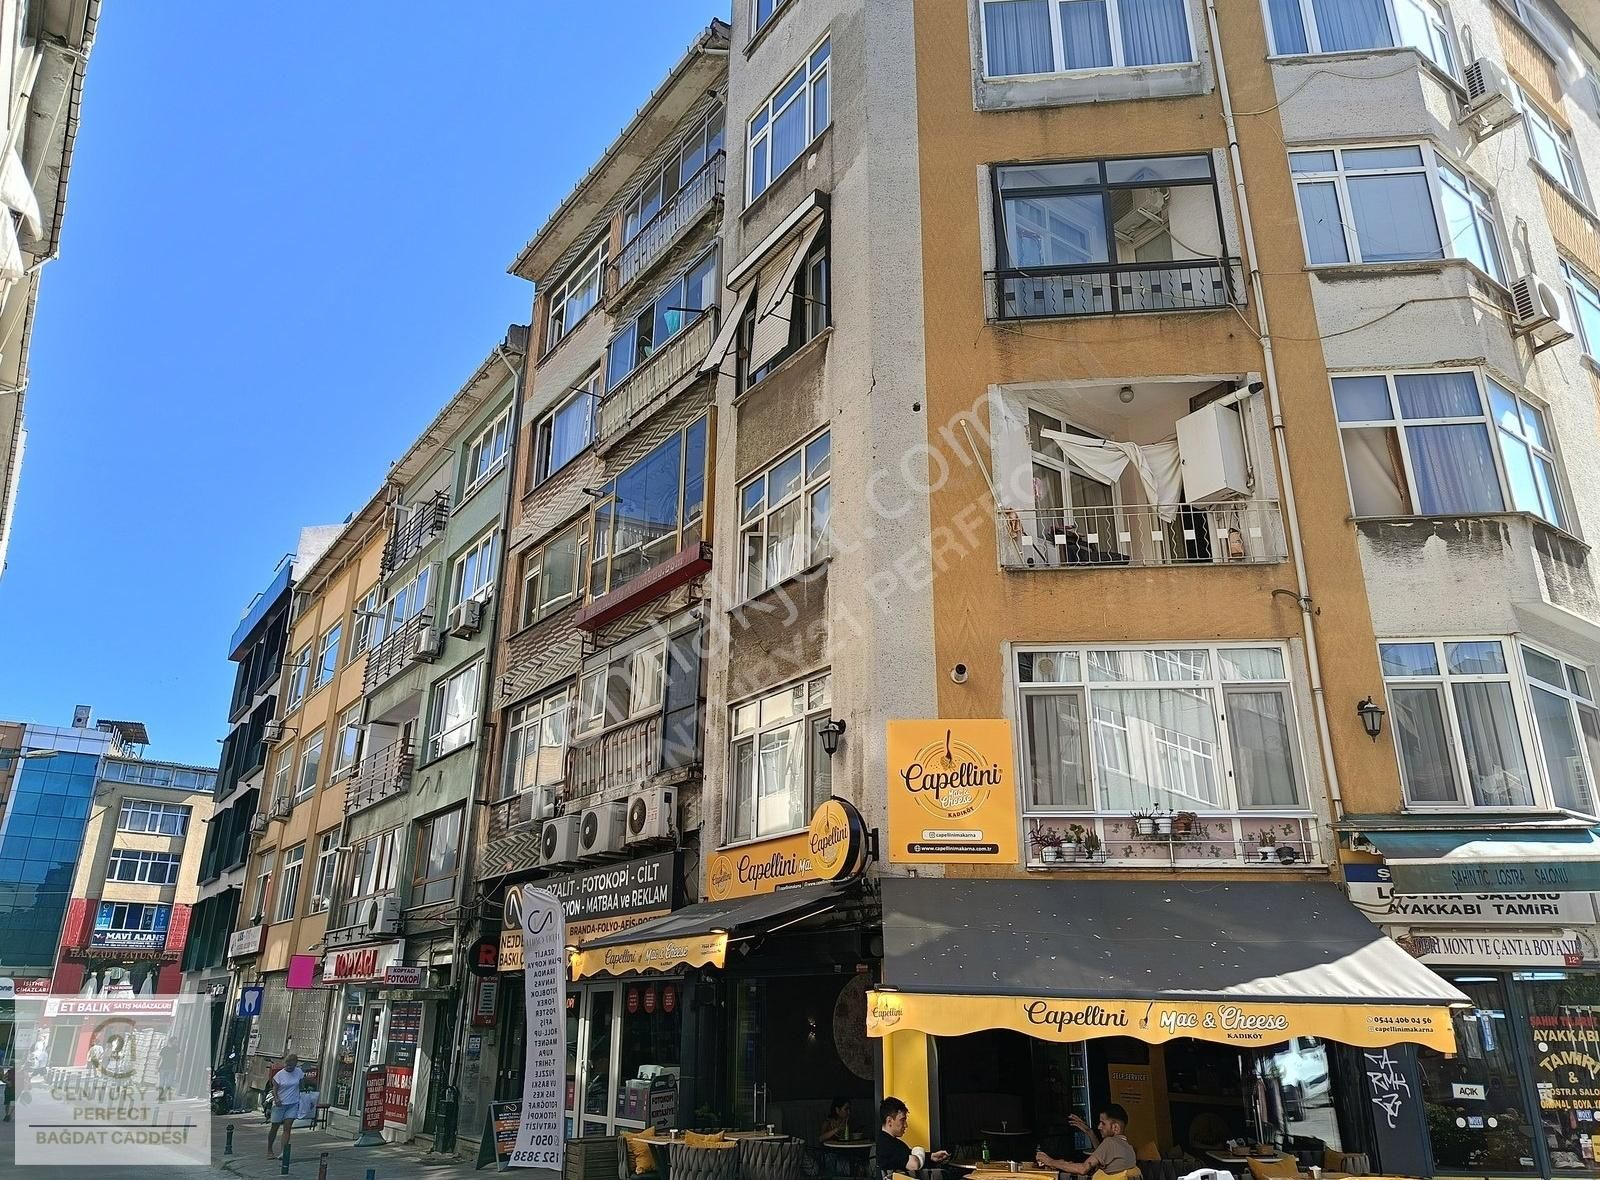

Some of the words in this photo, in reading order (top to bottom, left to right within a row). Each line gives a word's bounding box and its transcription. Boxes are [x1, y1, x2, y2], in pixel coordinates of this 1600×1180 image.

[900, 763, 1002, 799] Capellini
[940, 793, 972, 809] Cheese
[810, 824, 849, 858] Capellini
[581, 864, 629, 894] FOTOKOPİ
[637, 860, 660, 884] CİLT
[736, 853, 797, 891] Capellini
[1495, 868, 1526, 886] LOSTRA
[1534, 867, 1568, 884] SALONU
[586, 893, 619, 914] MATBAA
[620, 894, 630, 909] ve
[631, 884, 668, 907] REKLAM
[1387, 903, 1482, 915] AYAKKABI
[106, 931, 133, 941] MAVİ
[134, 932, 166, 942] AJANS
[1442, 938, 1475, 955] MONT
[1476, 938, 1492, 955] VE
[1493, 938, 1533, 960] ÇANTA
[334, 949, 378, 977] KOPYACI
[499, 952, 519, 966] BASKI
[605, 946, 636, 970] Capellini
[386, 974, 420, 984] FOTOKOPİ
[60, 1003, 76, 1012] ET
[78, 1003, 111, 1013] BALIK
[871, 1006, 903, 1020] Capellini
[1024, 1001, 1129, 1033] Capellini
[1160, 1010, 1198, 1034] Mac
[1205, 1012, 1216, 1028] &
[1218, 1005, 1289, 1031] Cheese
[1374, 1016, 1393, 1024] 0544
[1533, 1030, 1600, 1041] AYAKKABI
[1568, 1071, 1579, 1083] &
[1459, 1087, 1478, 1097] AÇIK
